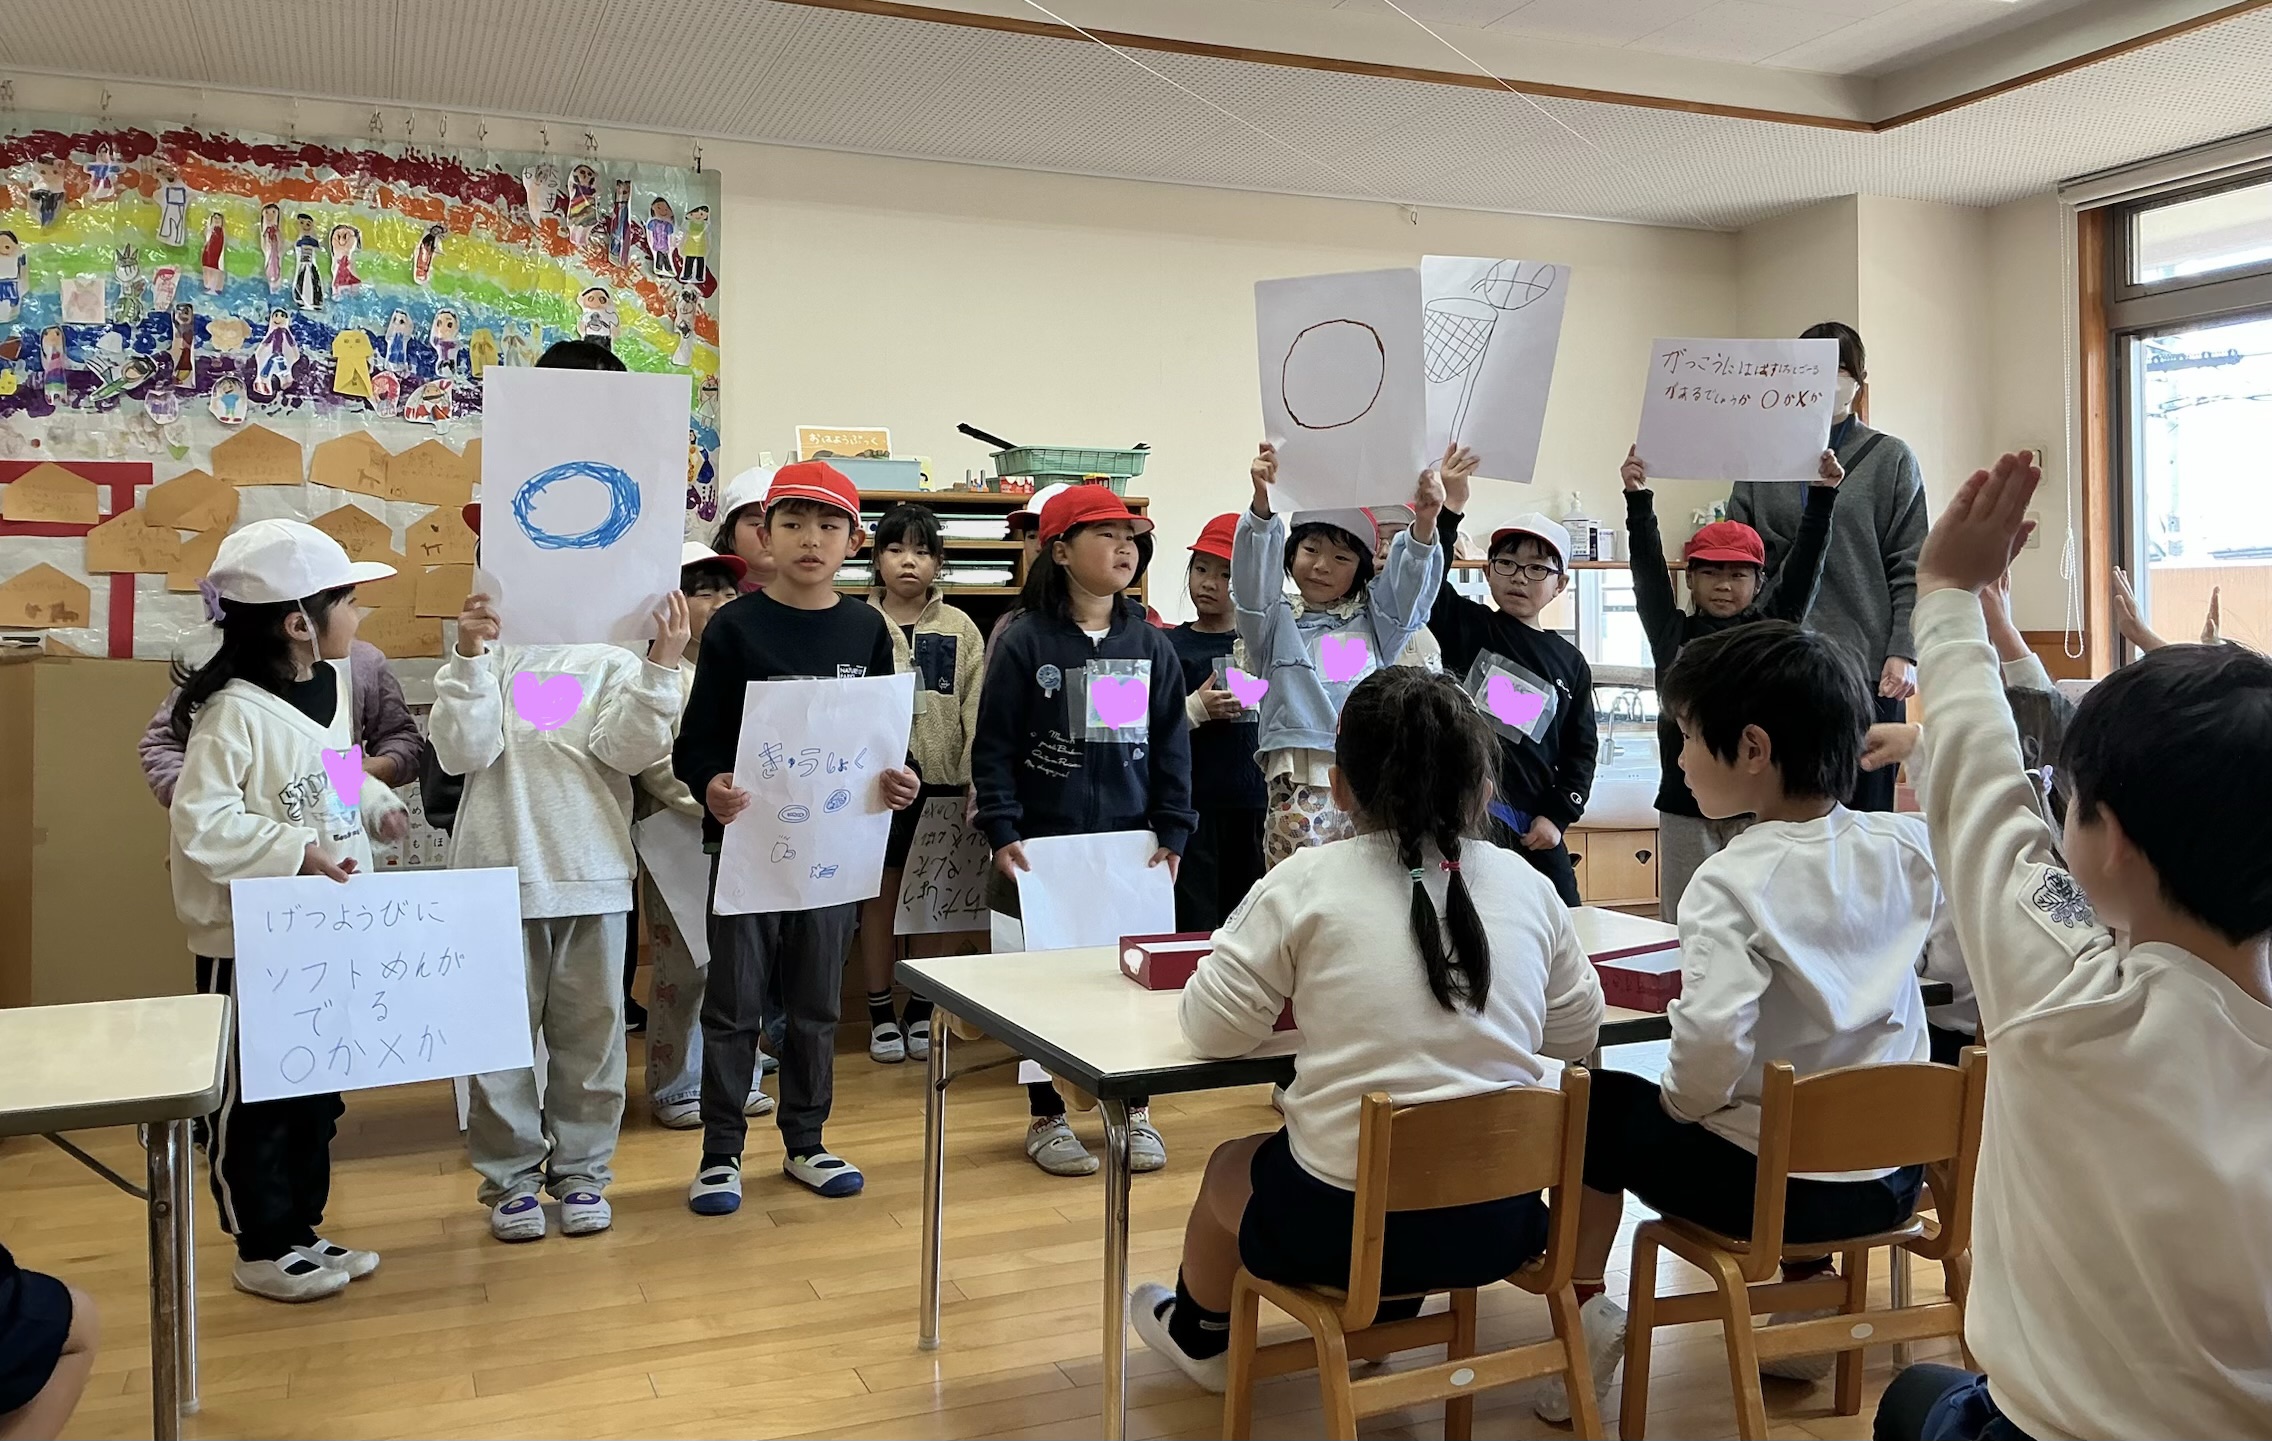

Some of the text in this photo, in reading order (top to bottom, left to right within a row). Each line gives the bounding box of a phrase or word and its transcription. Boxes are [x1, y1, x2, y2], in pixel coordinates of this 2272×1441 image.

[266, 900, 445, 933] げつようびに
[266, 947, 465, 992] ソフトめんが
